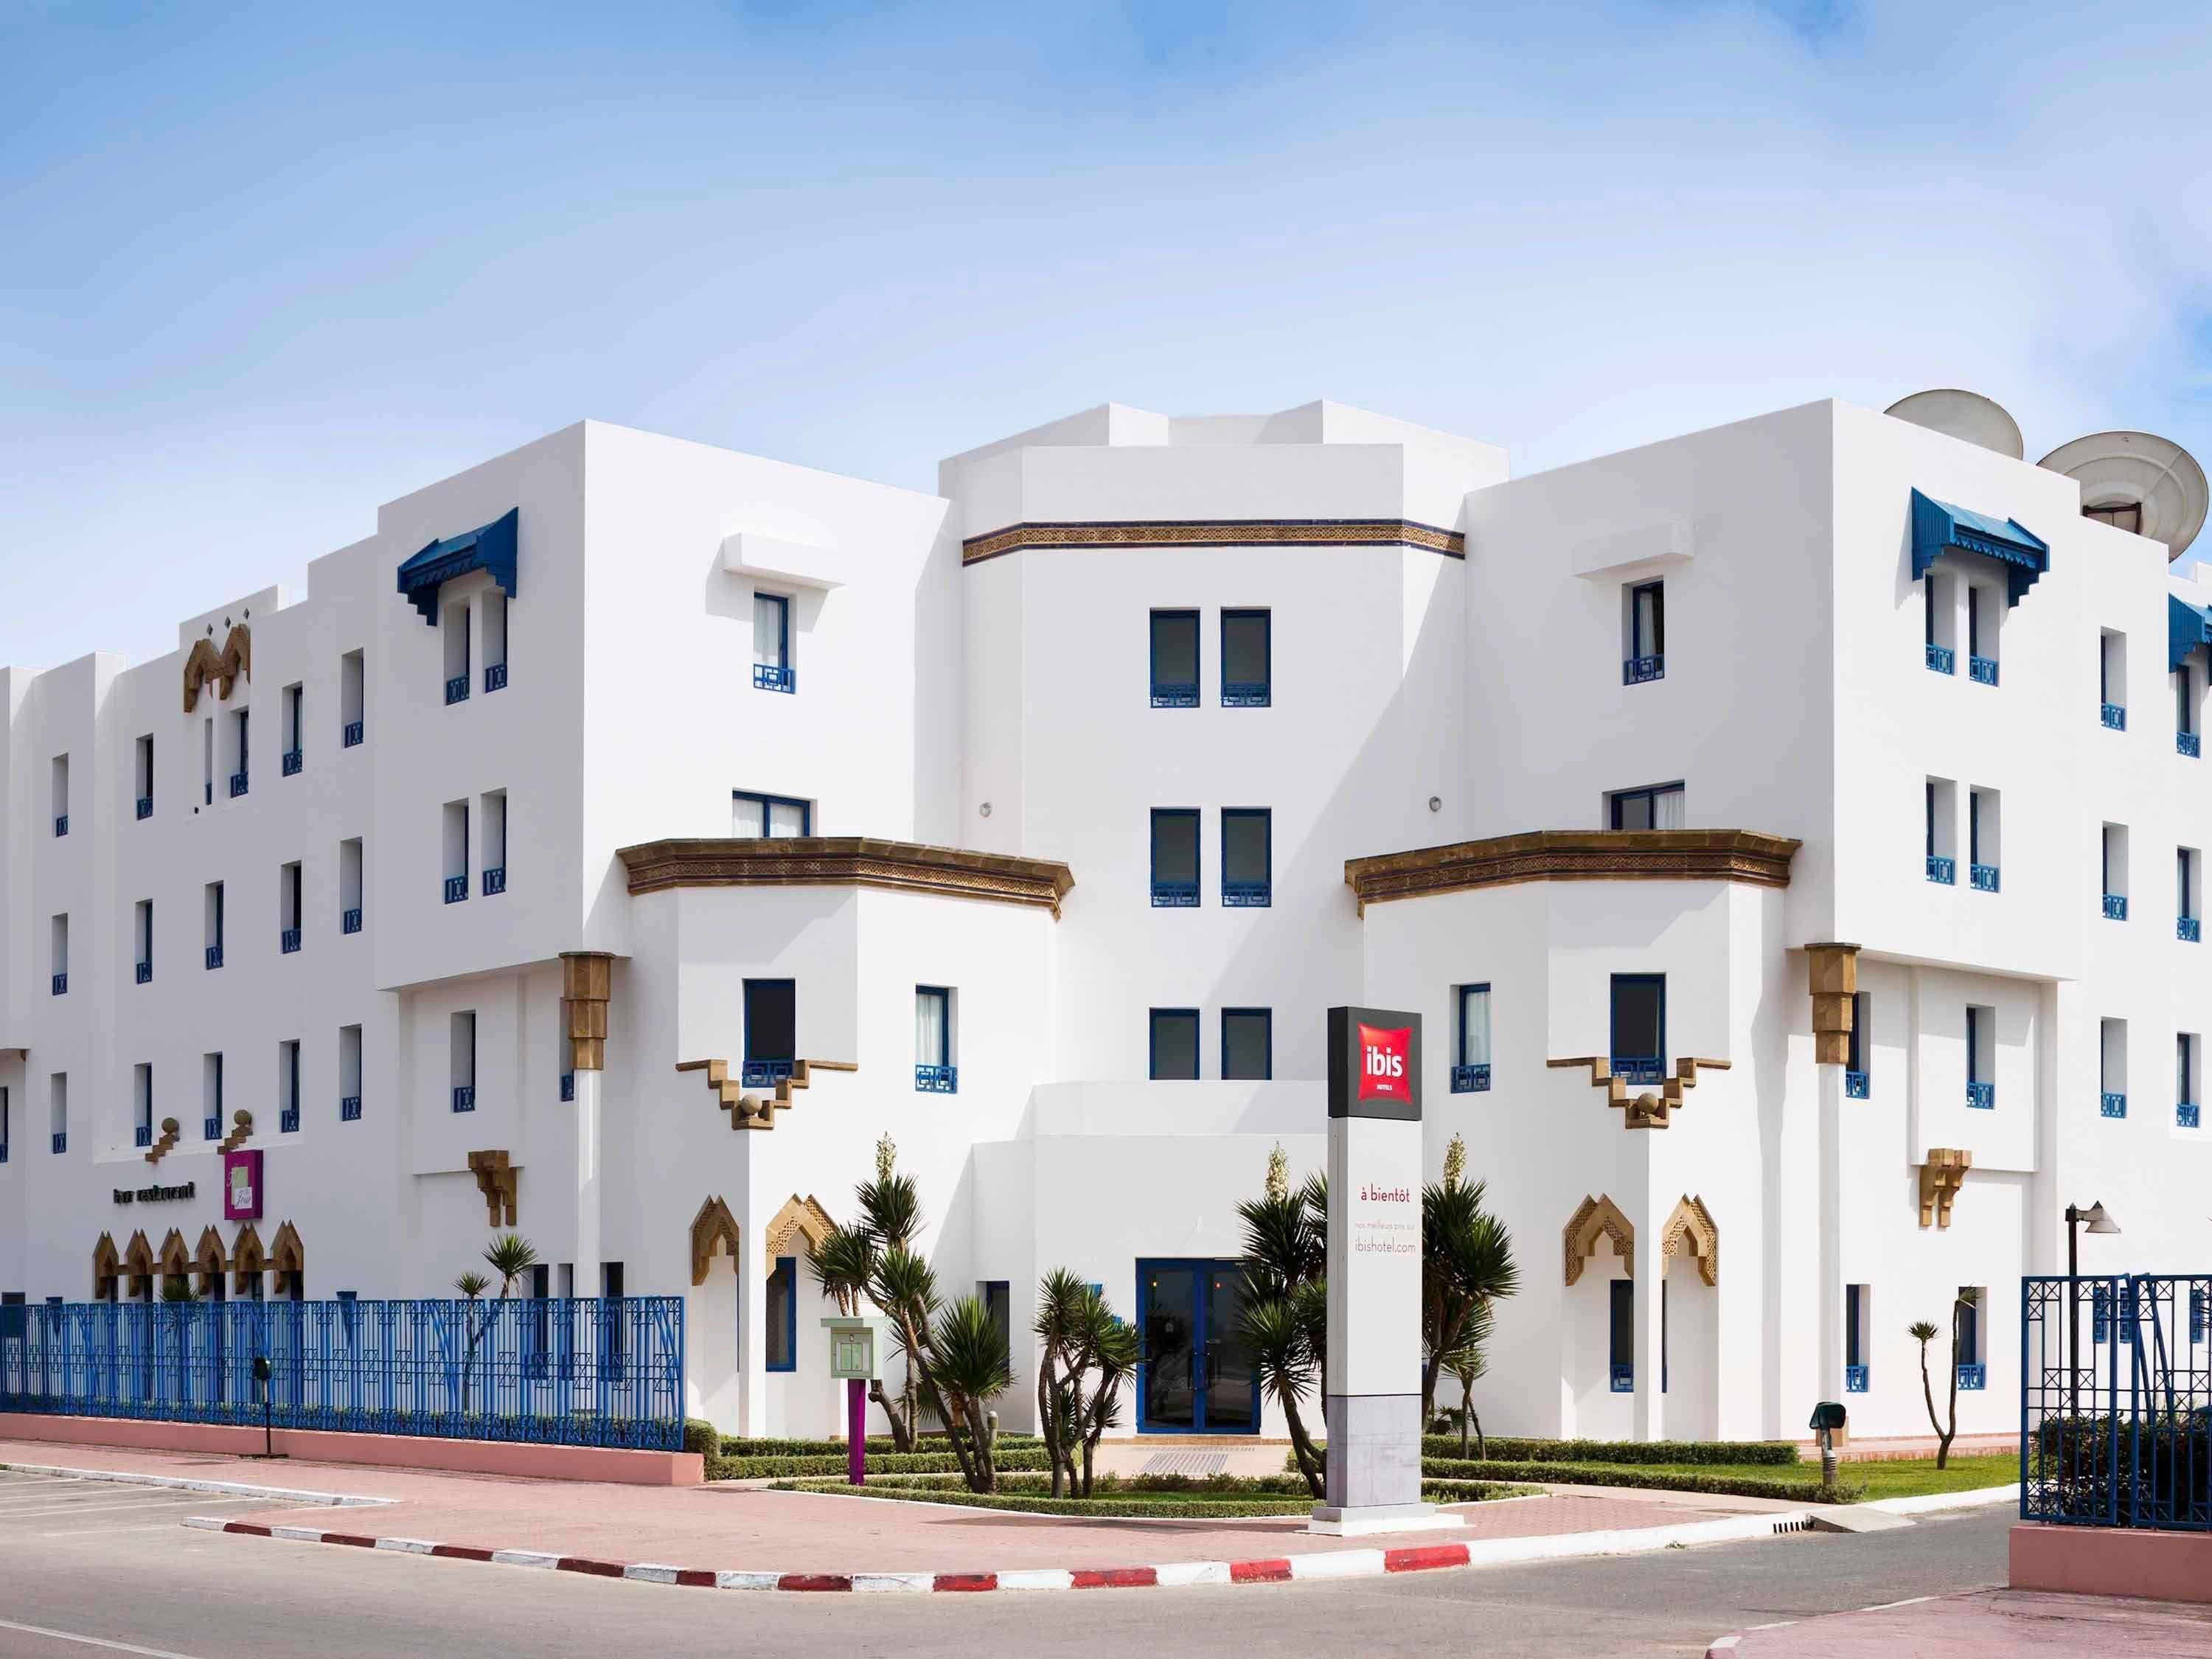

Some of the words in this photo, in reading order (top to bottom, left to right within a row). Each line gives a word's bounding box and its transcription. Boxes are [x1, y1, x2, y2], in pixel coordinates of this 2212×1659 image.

[1366, 1045, 1402, 1077] ibis
[1361, 1186, 1367, 1200] à
[1371, 1182, 1410, 1202] bientôt
[1355, 1234, 1416, 1253] ibishotel.com
